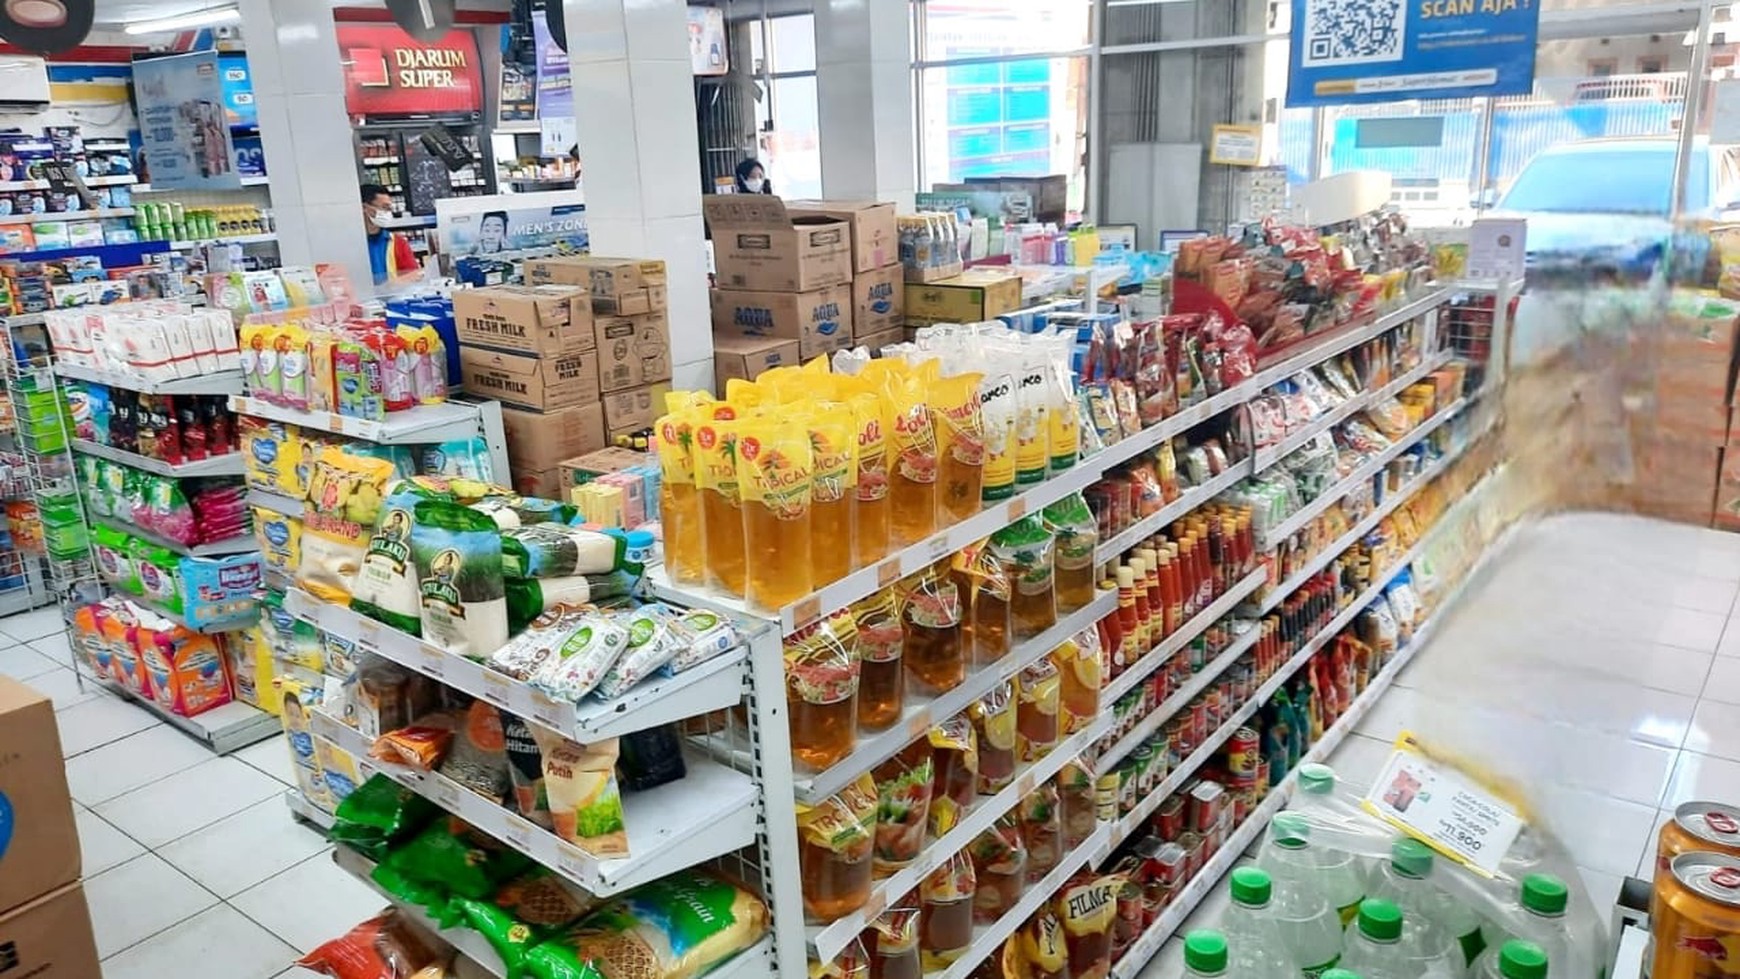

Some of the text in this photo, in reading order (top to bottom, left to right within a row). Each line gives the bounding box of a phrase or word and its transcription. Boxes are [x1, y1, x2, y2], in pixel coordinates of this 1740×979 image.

[1420, 0, 1474, 18] SCAN
[394, 48, 467, 68] DJARUM
[400, 69, 455, 87] SUPER
[513, 221, 554, 237] MEN'S
[868, 282, 893, 301] AQUA
[733, 306, 775, 328] AQUA
[812, 302, 840, 322] AQUA
[466, 317, 499, 333] FRESH
[500, 322, 527, 338] MILK
[555, 361, 582, 373] FRESH
[559, 369, 579, 380] MILK
[473, 373, 503, 389] FRESH
[504, 381, 528, 395] MILK
[1068, 884, 1114, 919] FILMA
